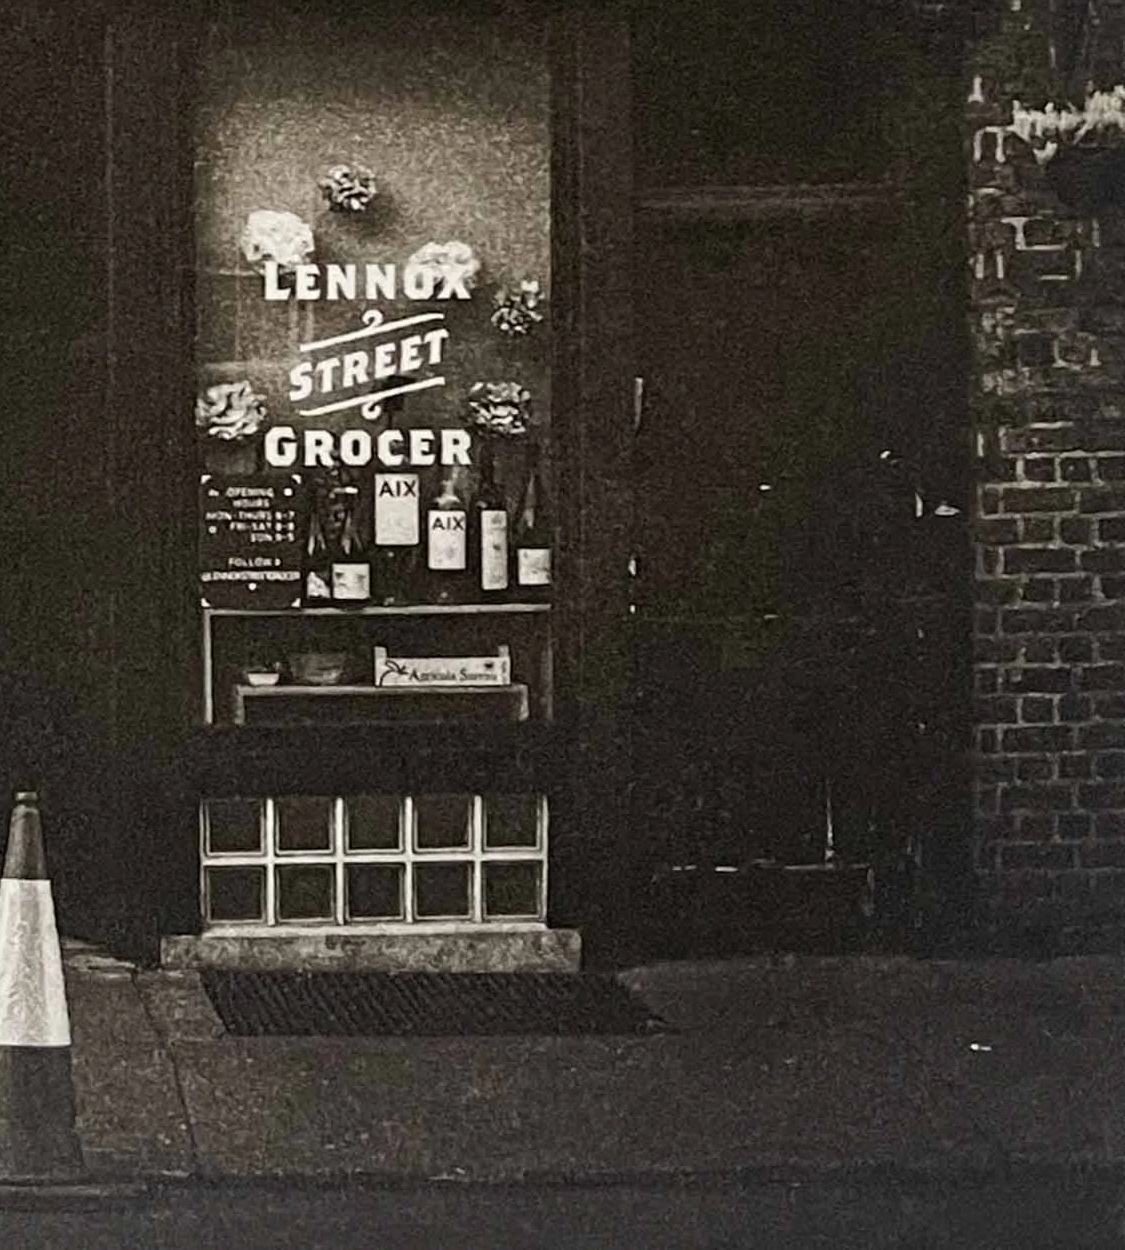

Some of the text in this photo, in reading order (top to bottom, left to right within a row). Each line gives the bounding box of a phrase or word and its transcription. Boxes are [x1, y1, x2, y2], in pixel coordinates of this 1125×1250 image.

[264, 260, 472, 300] LENNOX
[289, 328, 449, 401] STREET
[264, 426, 472, 466] GROCER
[379, 480, 416, 497] AIX
[431, 517, 465, 531] AIX
